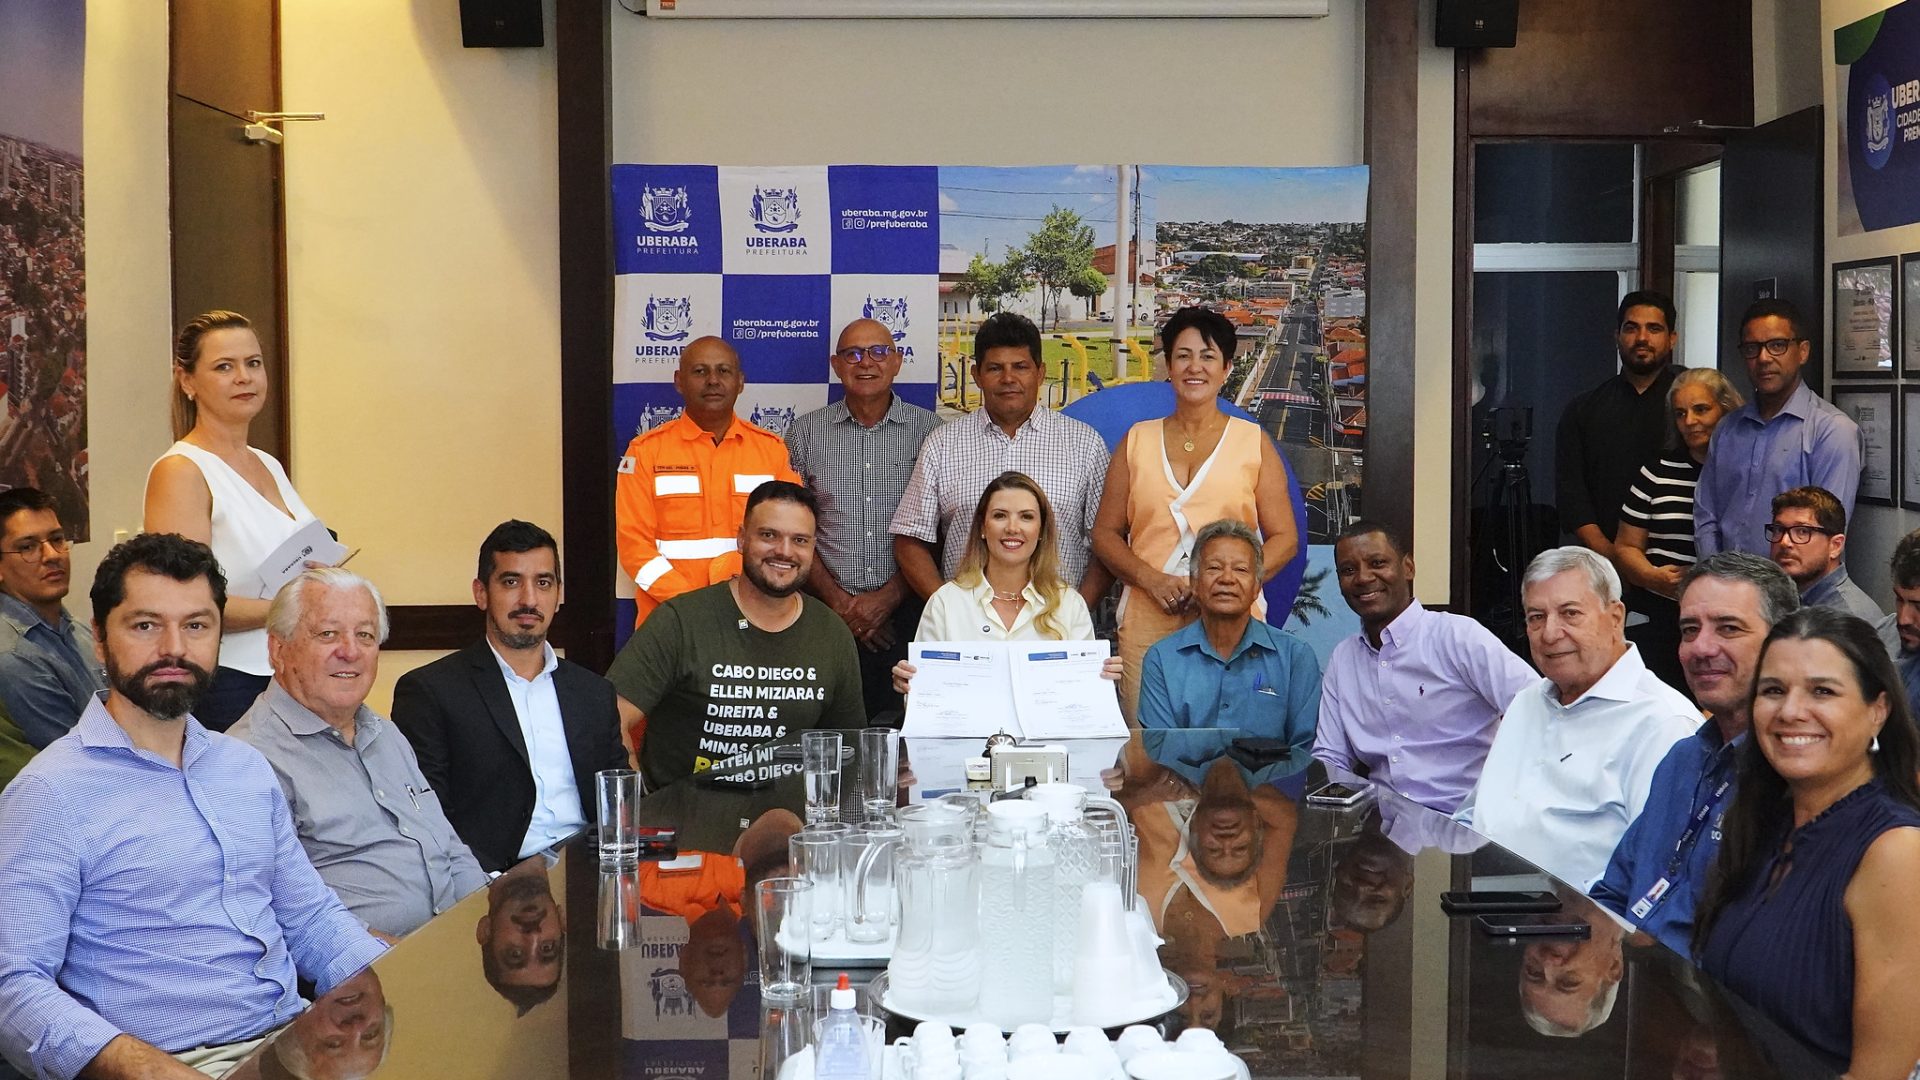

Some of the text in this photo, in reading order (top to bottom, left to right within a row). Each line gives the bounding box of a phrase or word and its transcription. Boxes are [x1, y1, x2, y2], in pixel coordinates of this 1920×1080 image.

[1891, 79, 1920, 109] UBER
[841, 209, 928, 219] uberaba.mg.gov.br
[866, 219, 928, 229] /prefuberaba
[637, 236, 698, 247] UBERABA
[746, 237, 807, 248] UBERABA
[733, 319, 820, 329] uberaba.mg.gov.br
[757, 329, 819, 339] /prefuberaba
[636, 345, 686, 356] UBERA
[712, 664, 817, 680] CABO DIEGO &
[710, 683, 825, 700] ELLEN MIZIARA &
[707, 703, 778, 719] DIREITA &
[703, 720, 787, 738] UBERABA &
[699, 737, 749, 755] MINAS
